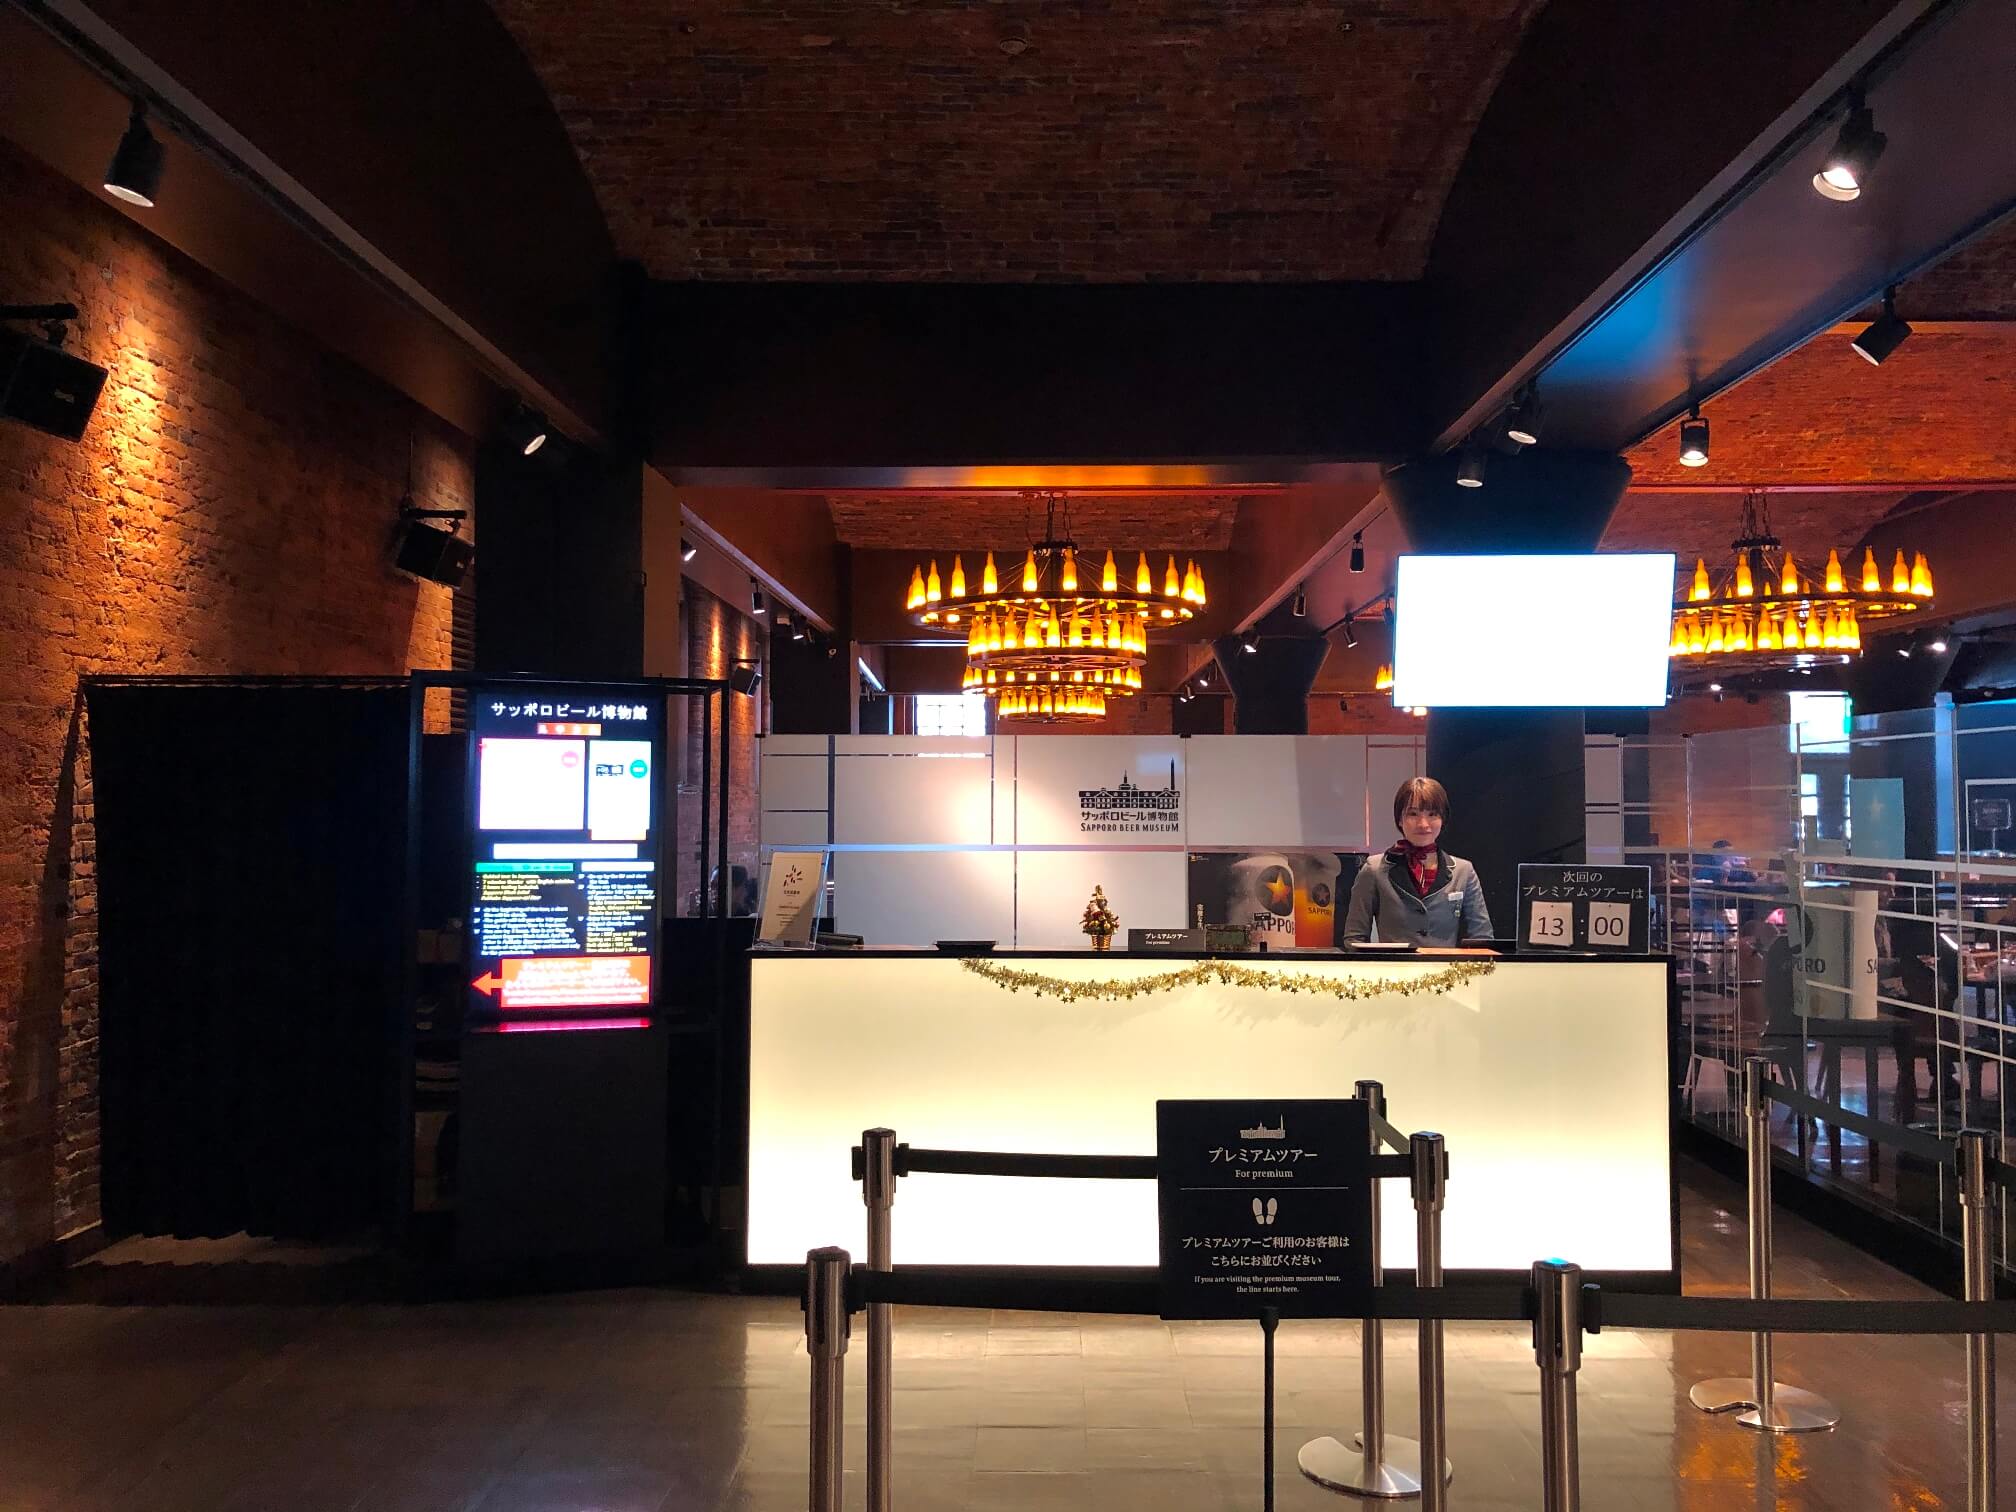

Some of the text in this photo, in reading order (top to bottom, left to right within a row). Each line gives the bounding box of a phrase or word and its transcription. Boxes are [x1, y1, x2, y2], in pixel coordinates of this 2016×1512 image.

[491, 702, 649, 721] サッポロビール博物館
[1081, 811, 1179, 821] サッポロビール博物館
[1080, 822, 1179, 832] SAPPORO BEER MUSEUM
[1562, 870, 1603, 883] 次回の
[1522, 885, 1644, 899] プレミアムツアーは
[1537, 916, 1564, 937] 13
[1594, 916, 1624, 937] 00
[1145, 932, 1189, 940] プレミアムツアー
[1208, 1146, 1318, 1163] プレミアムツアー
[1235, 1169, 1293, 1180] For premium
[1182, 1235, 1350, 1249] プレミアムツアーご利用のお客様は
[1211, 1254, 1322, 1267] こちらにお並びください
[1194, 1275, 1200, 1283] If
[1200, 1276, 1214, 1285] you
[1226, 1275, 1251, 1284] visiting
[1252, 1275, 1263, 1283] the
[1264, 1275, 1295, 1284] premium
[1295, 1275, 1324, 1283] museum
